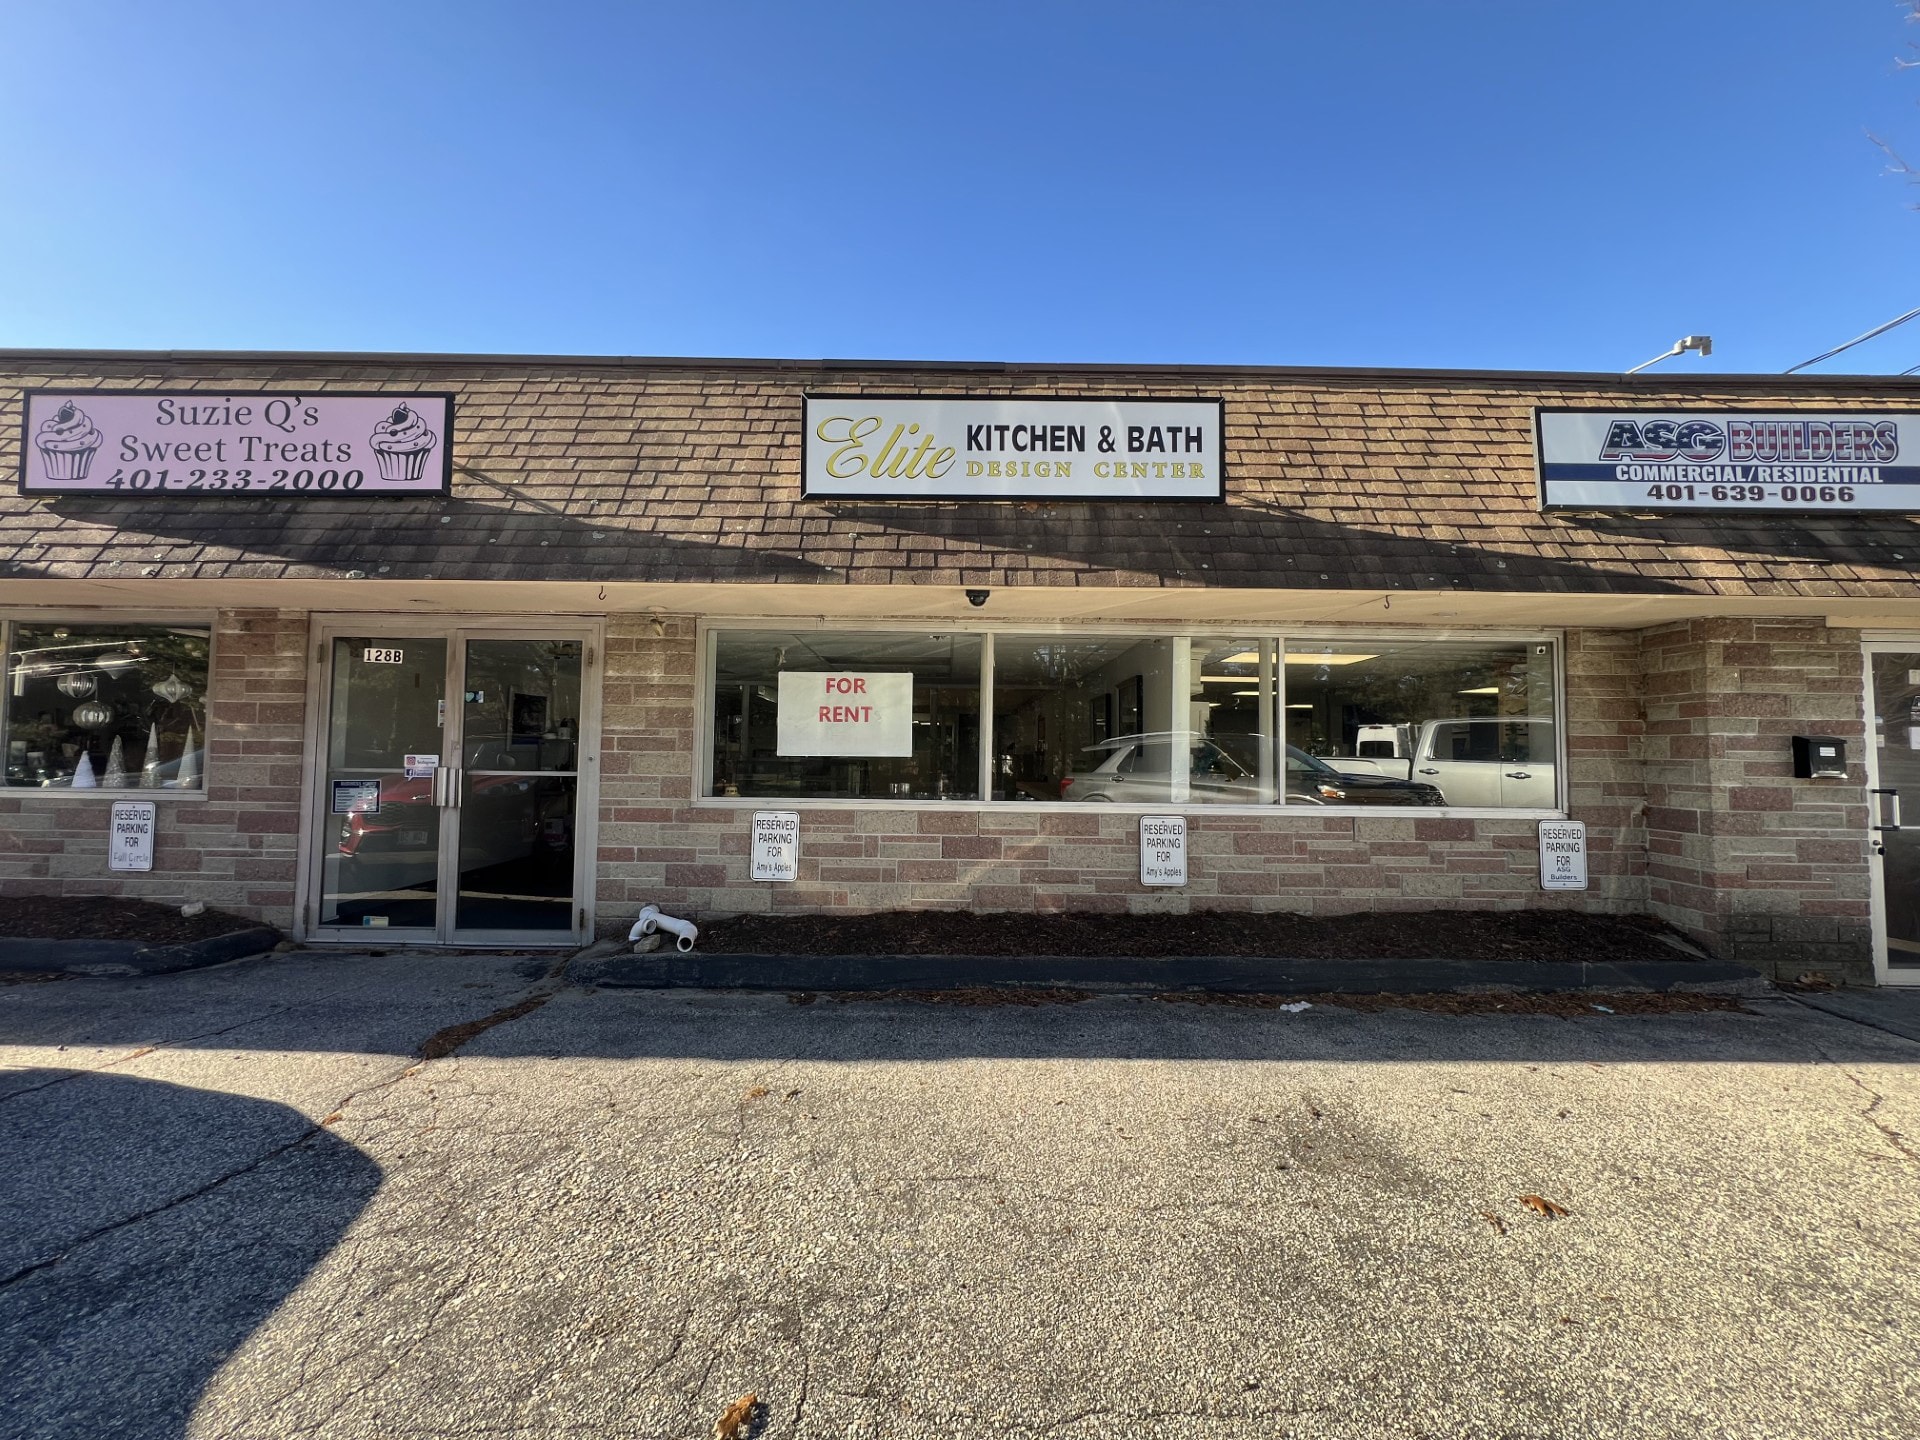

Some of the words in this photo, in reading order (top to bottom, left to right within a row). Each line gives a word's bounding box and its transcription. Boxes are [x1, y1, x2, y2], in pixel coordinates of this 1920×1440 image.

[156, 397, 252, 426] Suzie
[966, 424, 1086, 452] KITCHEN
[1099, 426, 1116, 453] &
[1127, 426, 1203, 453] BATH
[1599, 419, 1727, 463] ASG
[1727, 420, 1900, 464] BUILDERS
[120, 434, 227, 463] Sweet
[239, 436, 352, 463] Treats
[816, 415, 956, 479] Elite
[966, 460, 1072, 478] DESIGN
[1094, 461, 1206, 479] CENTER
[1615, 465, 1884, 483] COMMERCIAL/RESIDENTIAL
[105, 468, 364, 490] 401-233-2000
[1646, 484, 1856, 502] 401-639-0066
[366, 650, 402, 663] 128B
[825, 677, 867, 694] FOR
[818, 705, 874, 723] RENT
[115, 809, 152, 821] RESERVED
[116, 823, 149, 834] PARKING
[756, 819, 796, 831] RESERVED
[1143, 824, 1183, 835] RESERVED
[758, 832, 792, 844] PARKING
[1542, 828, 1582, 840] RESERVED
[125, 836, 139, 848] FOR
[1146, 837, 1181, 849] PARKING
[1545, 842, 1580, 853] PARKING
[767, 846, 782, 858] FOR
[1156, 851, 1171, 863] FOR
[1556, 855, 1571, 867] FOR
[1146, 866, 1163, 879] Amy's
[1164, 866, 1182, 878] Apples
[1550, 873, 1578, 881] Builders
